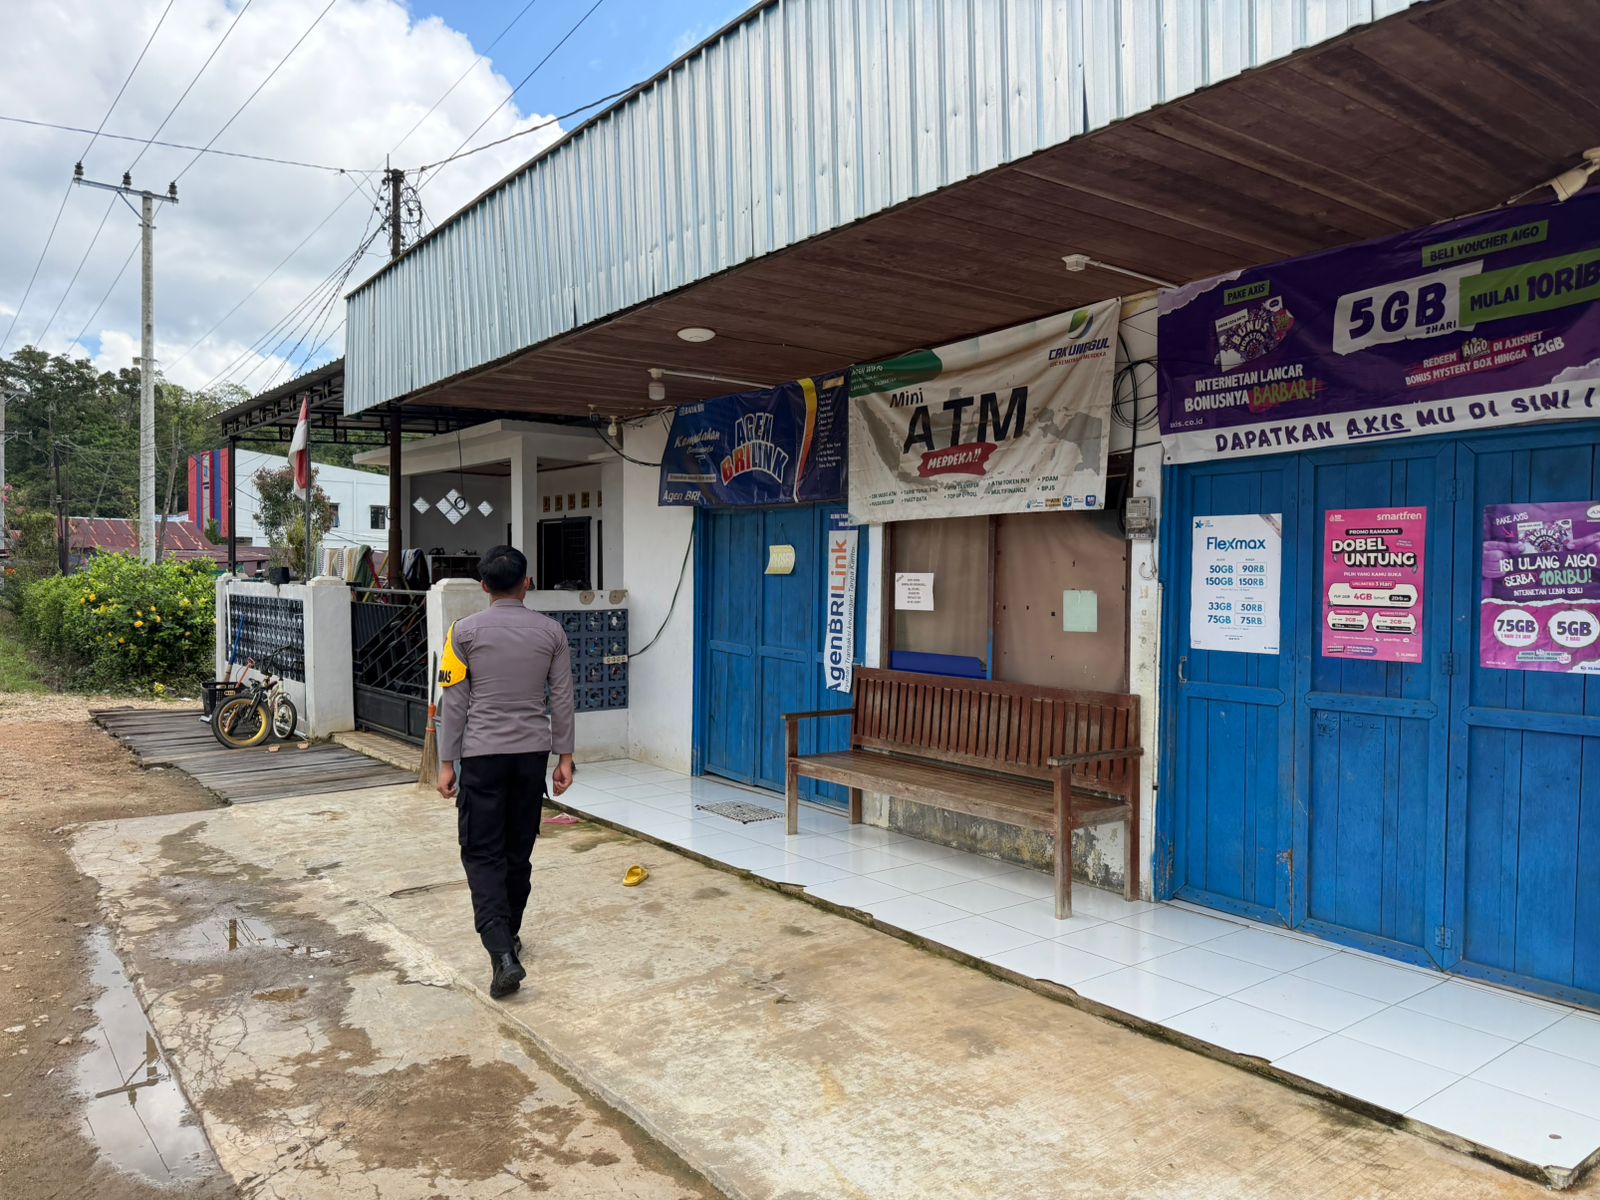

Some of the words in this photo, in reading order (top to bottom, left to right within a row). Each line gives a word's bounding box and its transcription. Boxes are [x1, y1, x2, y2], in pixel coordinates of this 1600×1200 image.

[1429, 247, 1454, 262] BELI
[1457, 235, 1508, 255] VOUCHER
[1511, 225, 1540, 243] AIGO
[1227, 290, 1247, 302] PAKE
[1248, 283, 1266, 296] AXIS
[1469, 284, 1520, 312] MULAI
[1348, 282, 1447, 340] 5GB
[1231, 319, 1269, 345] BONUS
[1423, 352, 1457, 369] REDEEM
[1461, 339, 1488, 358] AIGO
[1493, 339, 1503, 352] DI
[1504, 331, 1543, 350] AXISNET
[1405, 371, 1431, 386] BONUS
[1432, 363, 1471, 381] MYSTERY
[1473, 357, 1493, 370] BOX
[1494, 350, 1528, 367] HINGGA
[1531, 336, 1565, 358] 12GB
[1195, 371, 1258, 392] INTERNETAN
[1260, 363, 1303, 382] LANCAR
[890, 387, 924, 408] Mini
[1184, 389, 1249, 413] BONUSNYA
[903, 386, 1028, 454] ATM
[1215, 421, 1334, 452] DAPATKAN
[1347, 413, 1405, 436] AXIS
[1416, 404, 1456, 426] MU
[1468, 400, 1499, 420] DI
[1511, 389, 1570, 413] SINI
[735, 412, 774, 449] AGEN
[720, 440, 789, 487] BRILINK
[927, 448, 982, 470] MERDEKA!!
[662, 490, 684, 503] Agen
[1376, 511, 1422, 521] smartfren
[1496, 515, 1512, 525] PAKE
[1513, 511, 1529, 523] AXIS
[1206, 536, 1266, 553] Flexmax
[1332, 537, 1387, 553] DOBEL
[1344, 552, 1416, 567] UNTUNG
[1499, 559, 1514, 572] ISI
[1518, 555, 1560, 570] ULANG
[1564, 553, 1598, 568] AIGO
[1209, 564, 1234, 574] 50GB
[1241, 564, 1265, 574] 90RB
[1504, 572, 1535, 587] SERBA
[1539, 568, 1593, 586] 10RIBU!
[848, 570, 856, 592] Tanpa
[1205, 576, 1234, 587] 150GB
[1238, 577, 1265, 587] 150RB
[1353, 593, 1373, 601] 4GB
[1513, 588, 1547, 597] INTERNETAN
[1548, 588, 1566, 596] LEBIH
[1208, 602, 1233, 612] 33GB
[1240, 603, 1264, 613] 50RB
[1207, 615, 1232, 625] 75GB
[1240, 616, 1264, 626] 75RB
[1497, 619, 1537, 634] 7.5GB
[1556, 621, 1592, 637] 5GB
